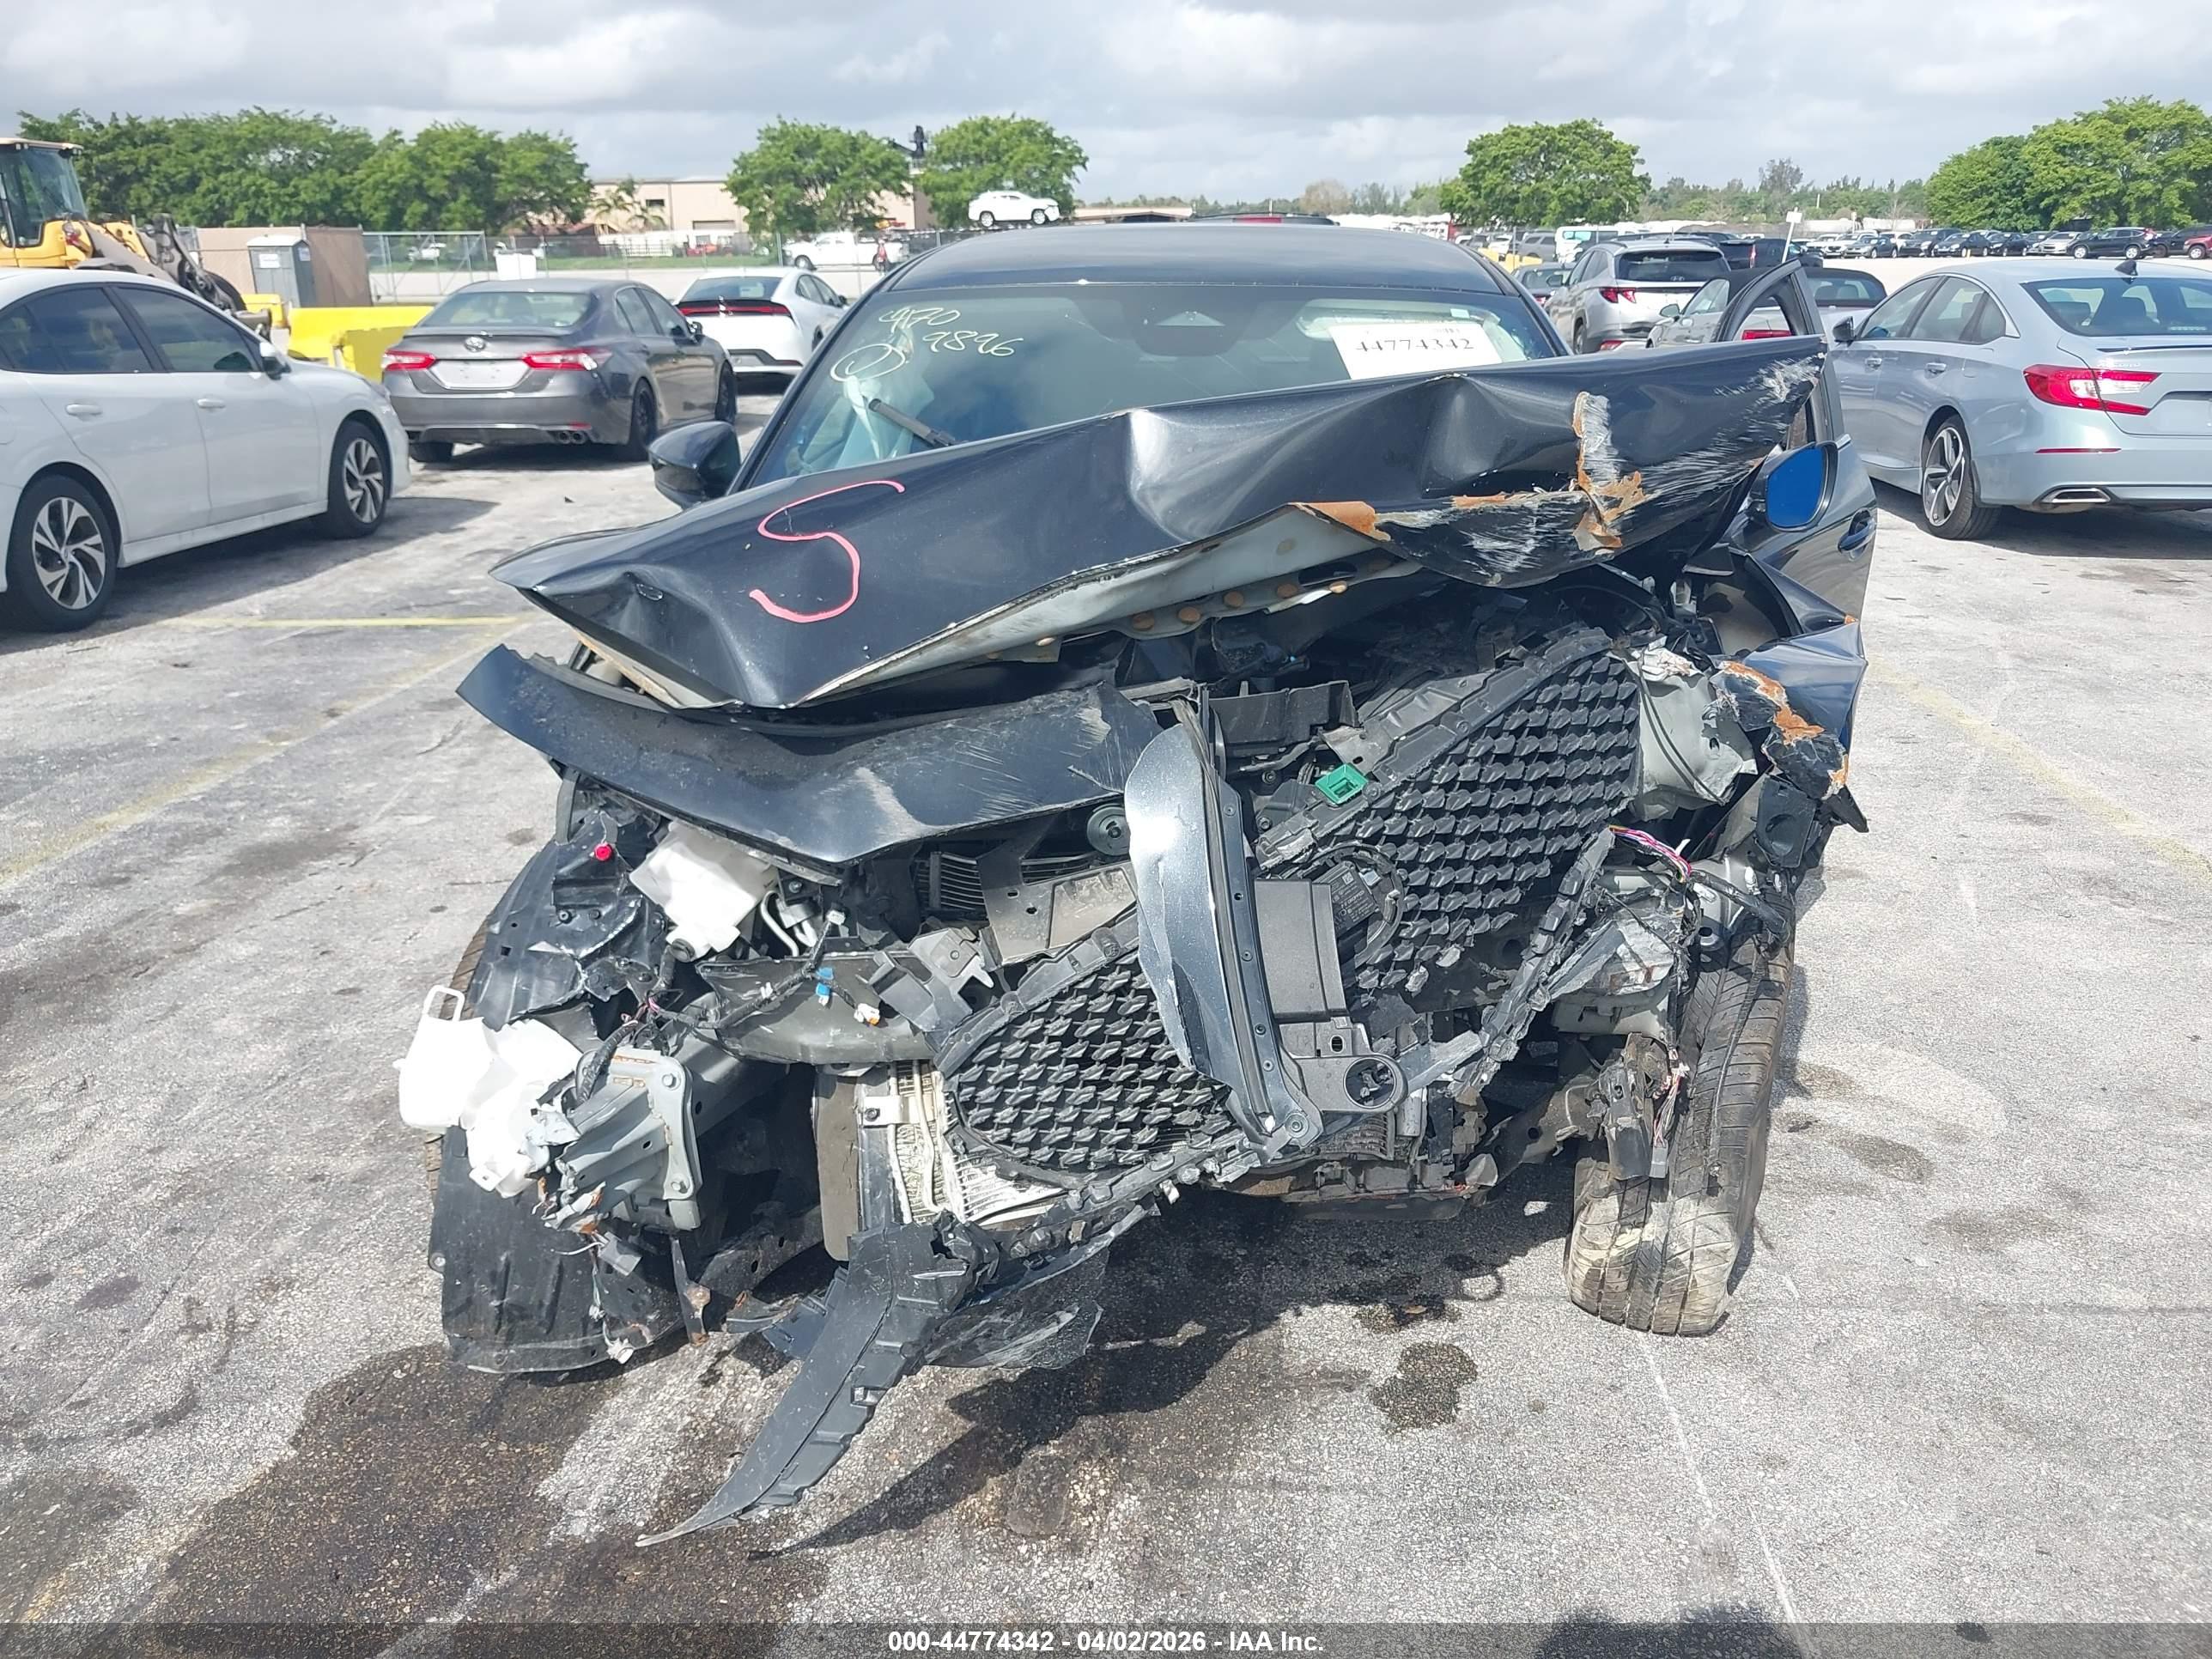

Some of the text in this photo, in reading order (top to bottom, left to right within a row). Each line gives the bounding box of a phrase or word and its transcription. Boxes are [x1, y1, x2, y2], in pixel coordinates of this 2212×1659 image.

[922, 331, 1024, 356] 9896
[1355, 338, 1474, 352] 44774342
[749, 480, 906, 623] S
